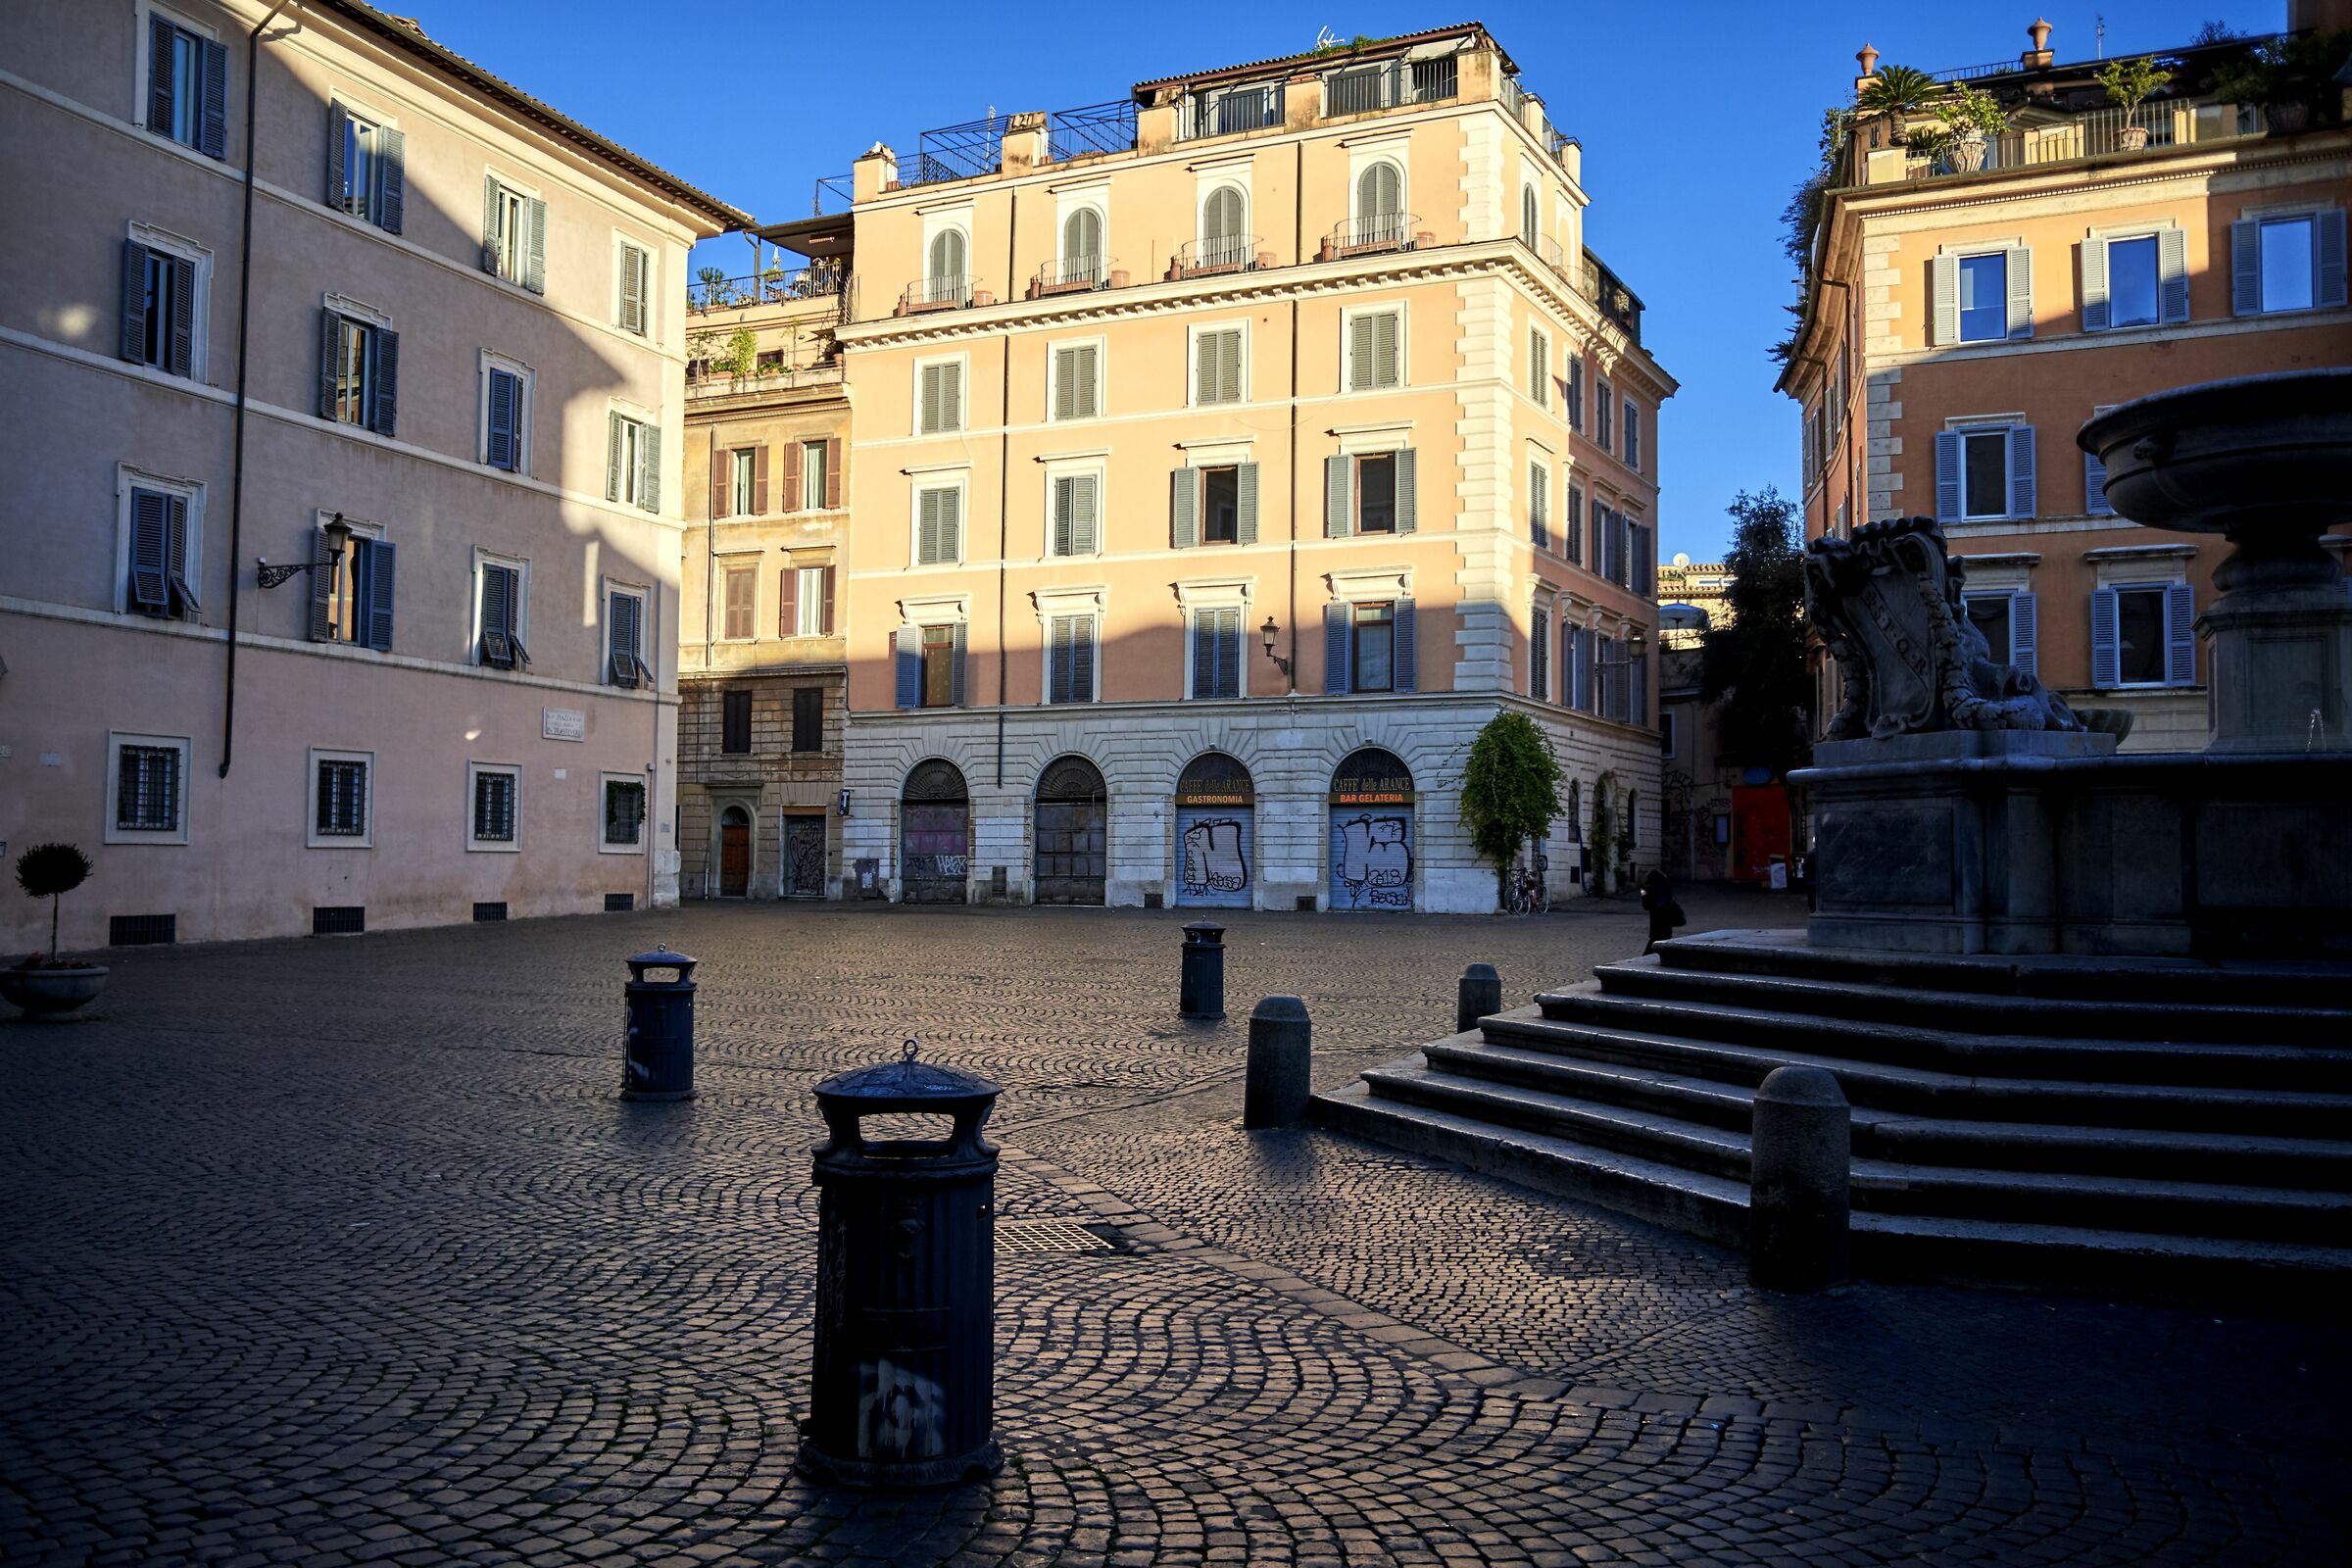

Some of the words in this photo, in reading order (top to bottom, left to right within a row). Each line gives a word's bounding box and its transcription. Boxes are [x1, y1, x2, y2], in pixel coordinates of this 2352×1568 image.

[1379, 777, 1410, 791] ARANCE
[1187, 795, 1244, 804] GASTRONOMIA
[1340, 794, 1357, 803] BAR
[1358, 793, 1403, 803] GELATERIA
